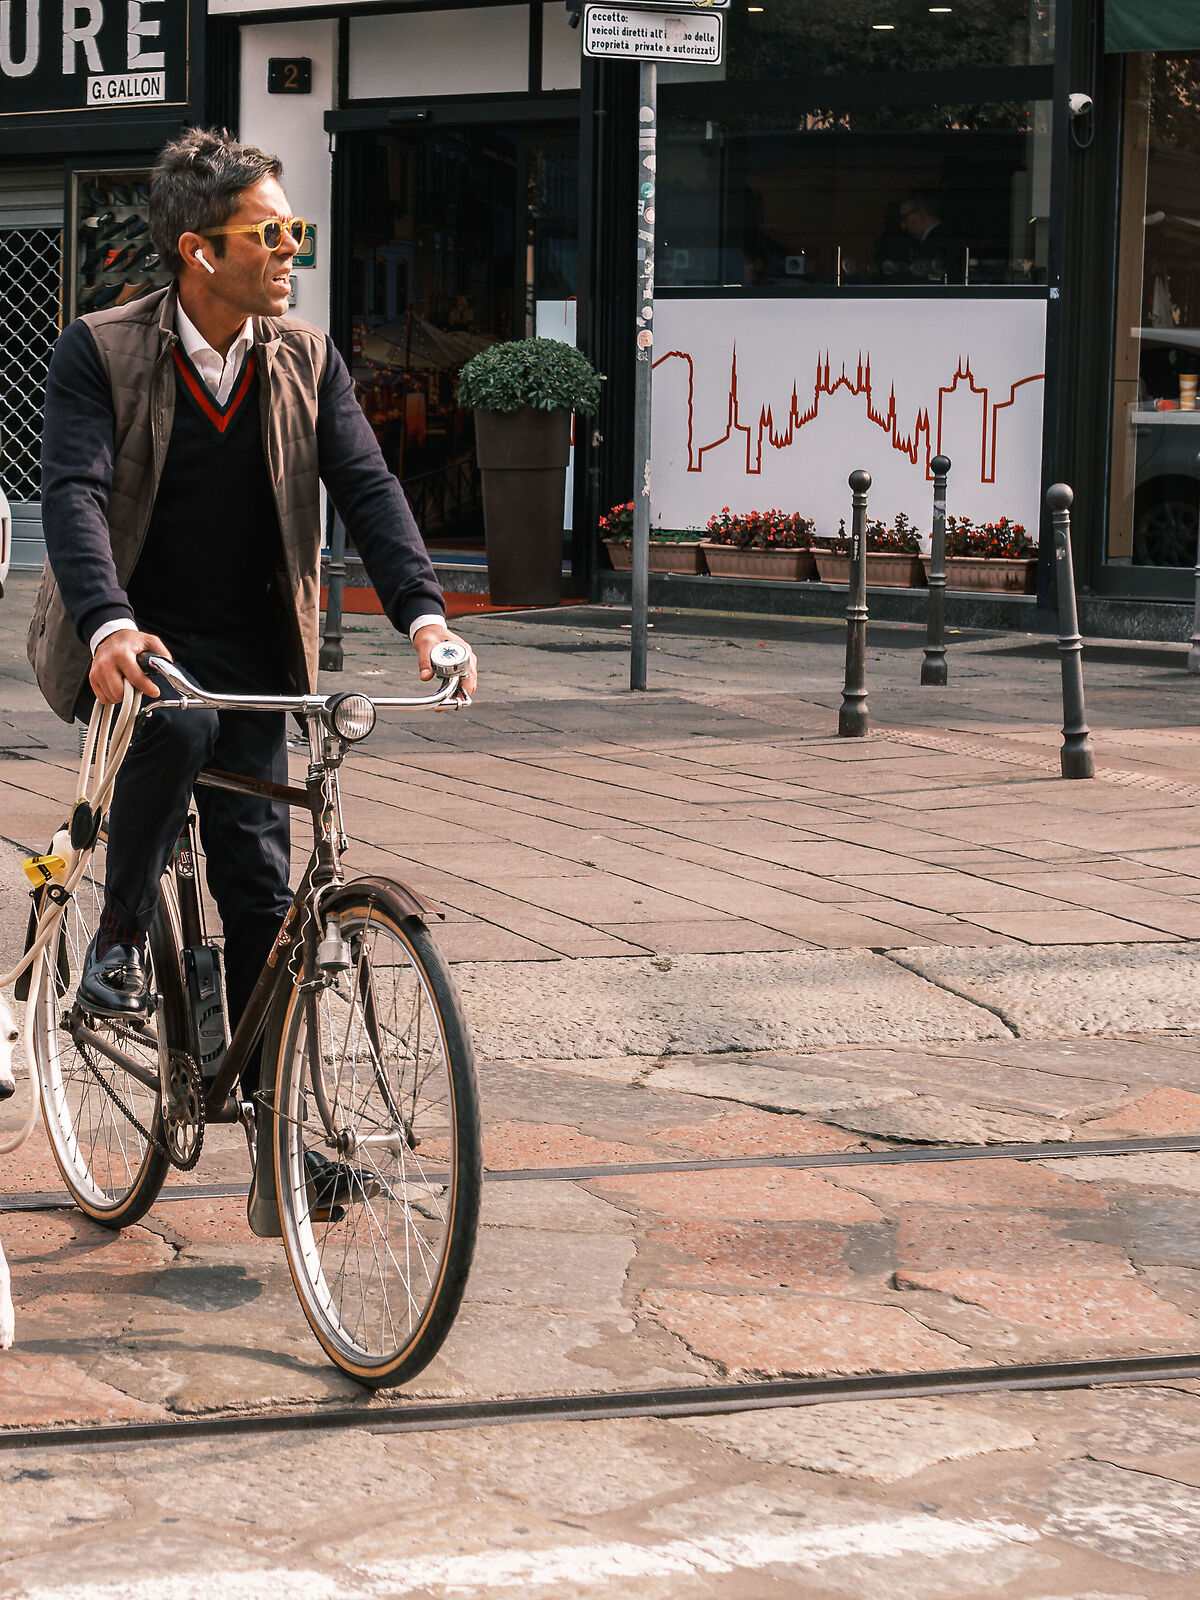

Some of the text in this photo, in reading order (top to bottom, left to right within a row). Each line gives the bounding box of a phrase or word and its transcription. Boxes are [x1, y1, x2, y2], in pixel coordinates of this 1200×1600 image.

[592, 12, 628, 22] eccetto:
[592, 25, 619, 35] veicoli
[621, 27, 648, 37] diretti
[695, 32, 715, 42] delle
[592, 40, 629, 50] proprietà
[635, 42, 663, 52] private
[673, 45, 716, 55] autorizzati
[284, 64, 297, 87] 2
